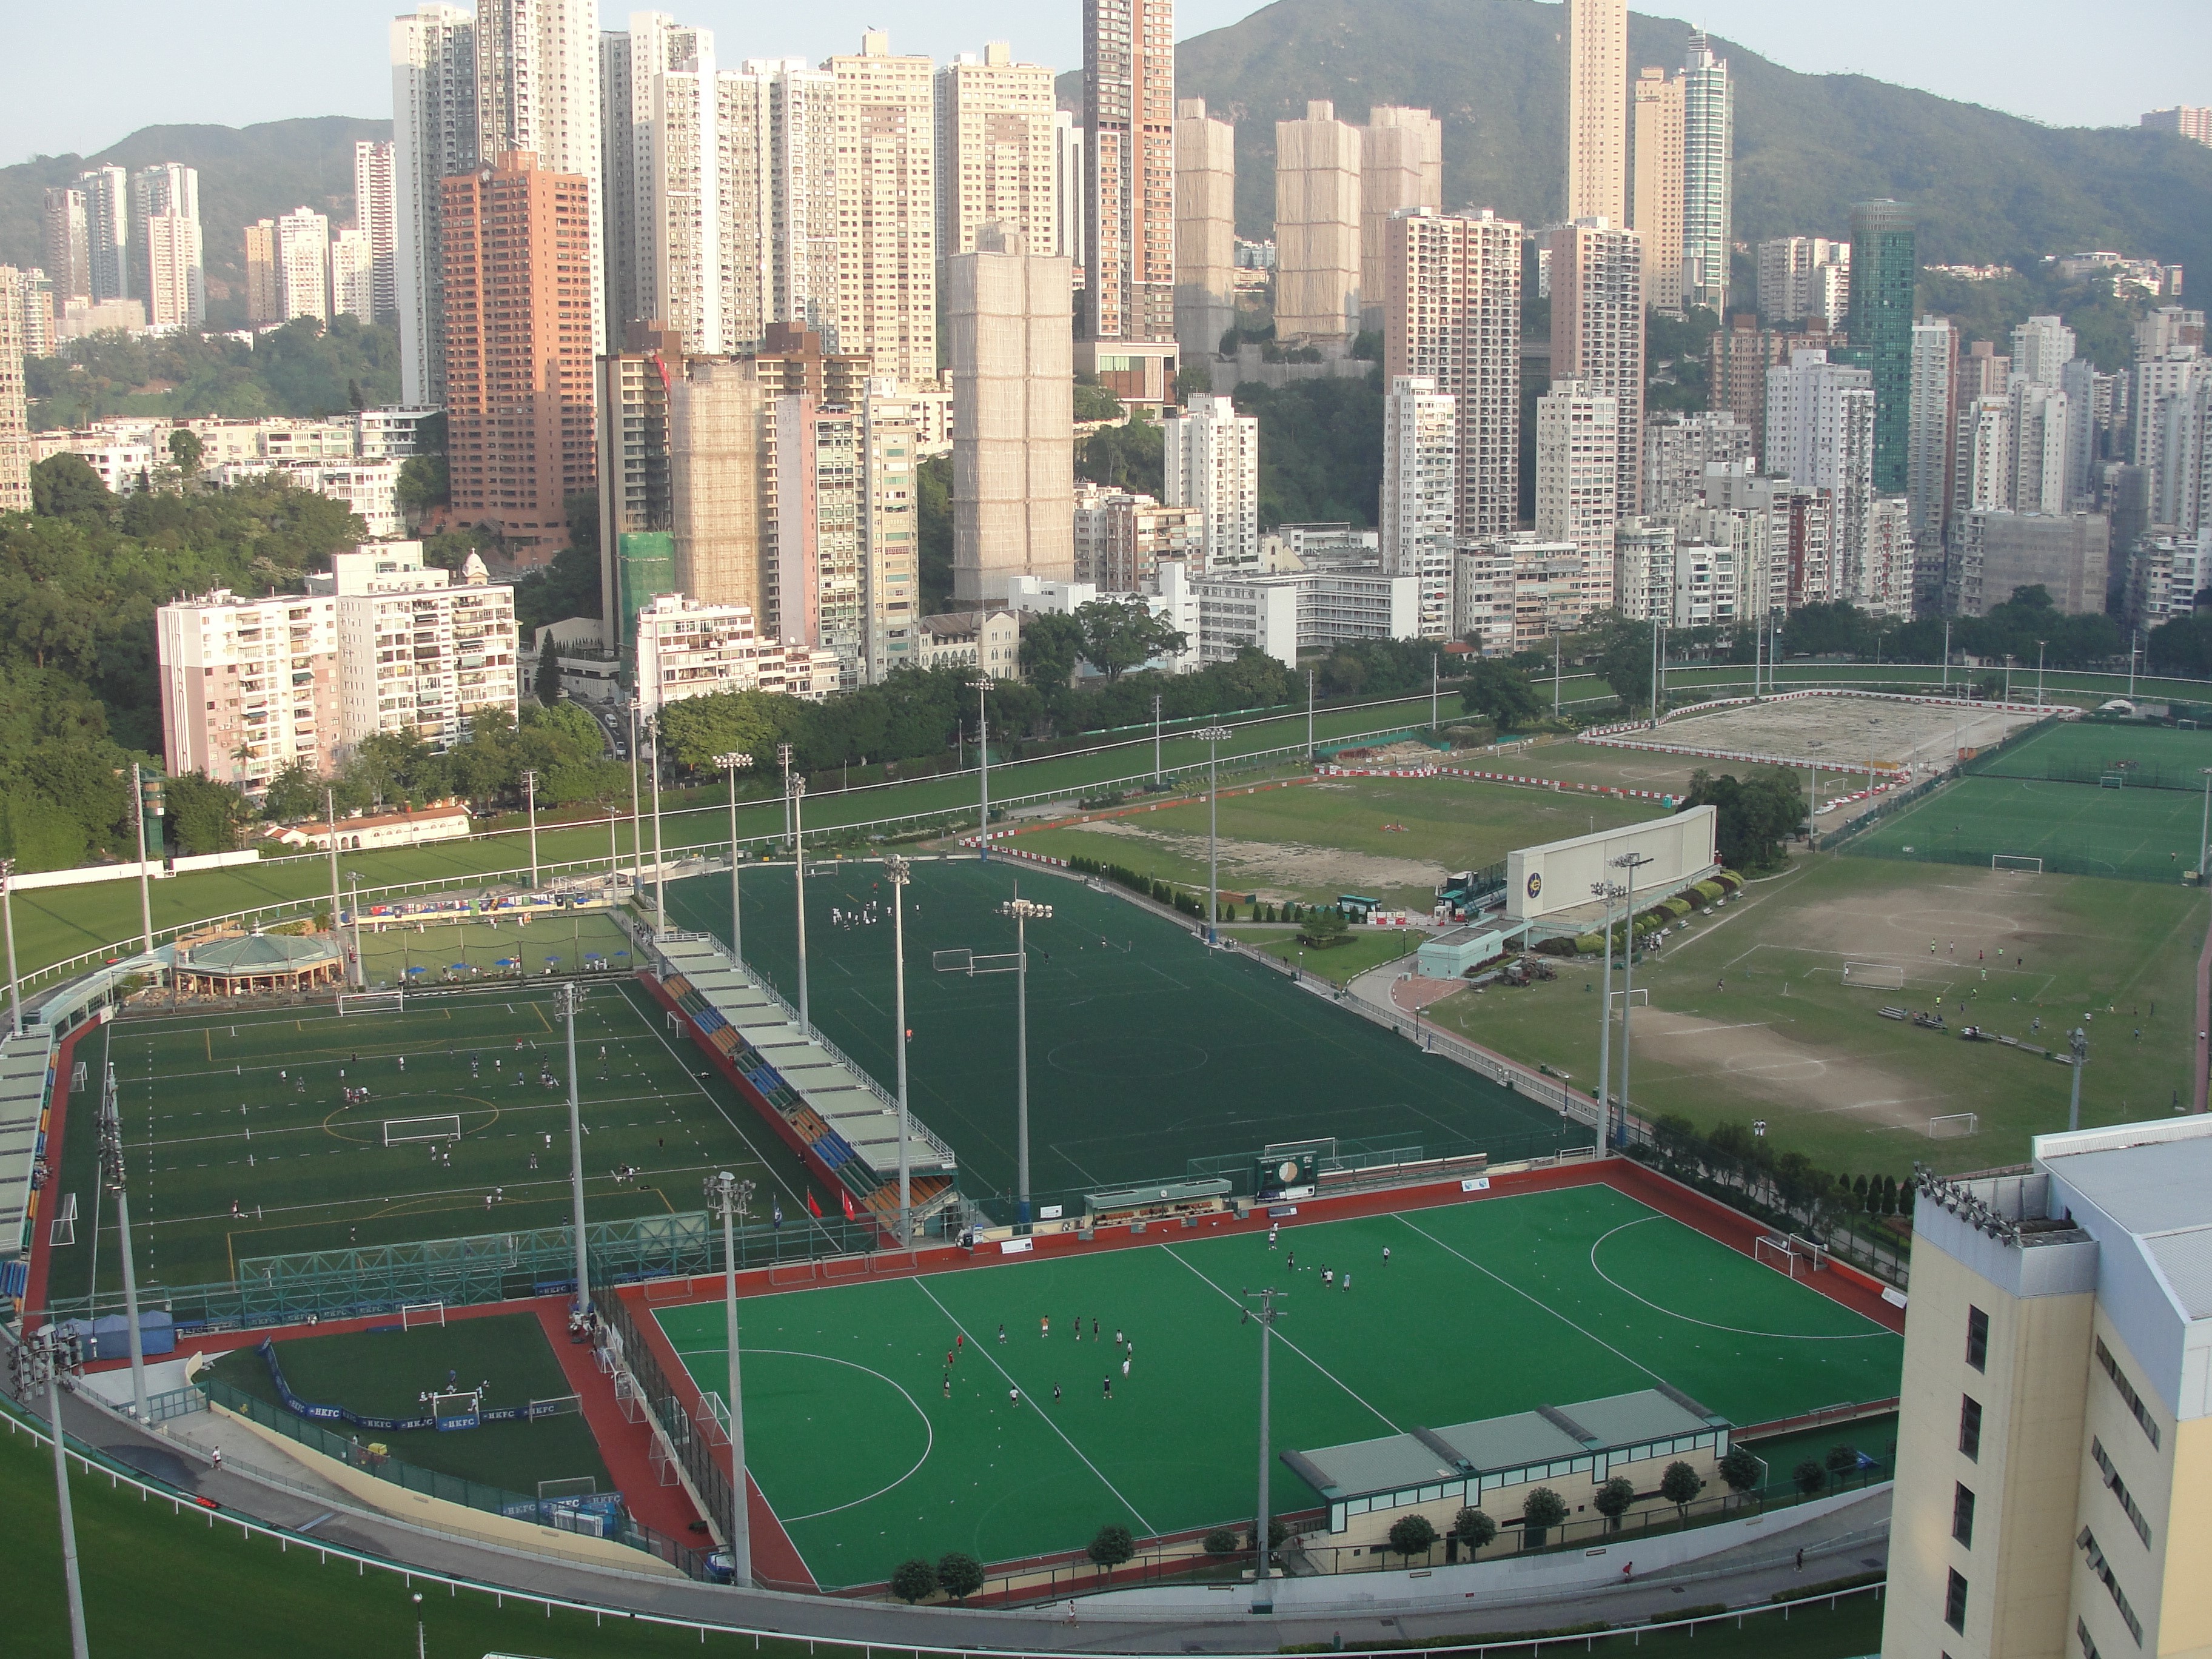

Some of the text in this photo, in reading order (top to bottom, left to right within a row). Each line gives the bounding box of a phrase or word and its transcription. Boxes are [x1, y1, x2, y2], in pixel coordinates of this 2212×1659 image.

[315, 1408, 340, 1418] HKFC
[489, 1411, 515, 1419] HKFC
[448, 1418, 475, 1427] HKFC
[508, 1504, 536, 1515] HKFC
